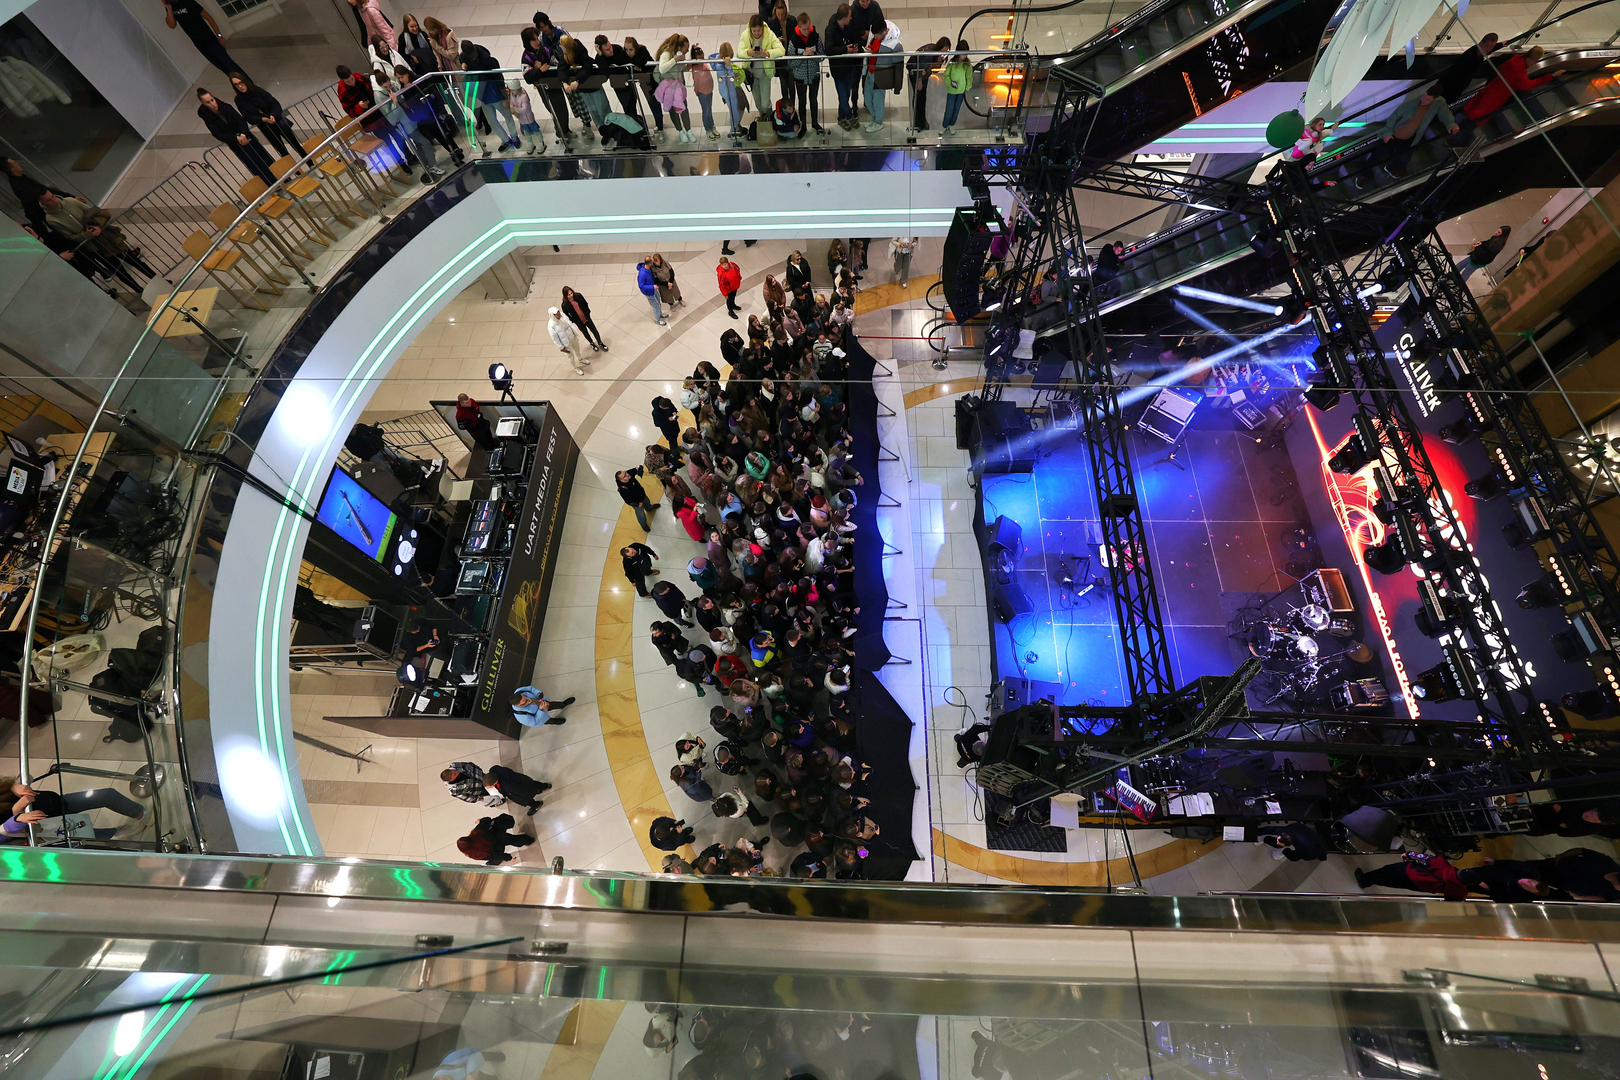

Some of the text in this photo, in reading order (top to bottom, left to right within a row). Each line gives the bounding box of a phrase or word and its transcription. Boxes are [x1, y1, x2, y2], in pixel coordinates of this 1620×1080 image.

[524, 426, 557, 555] UART MEDIA FEST
[481, 638, 504, 710] GULLIVER
